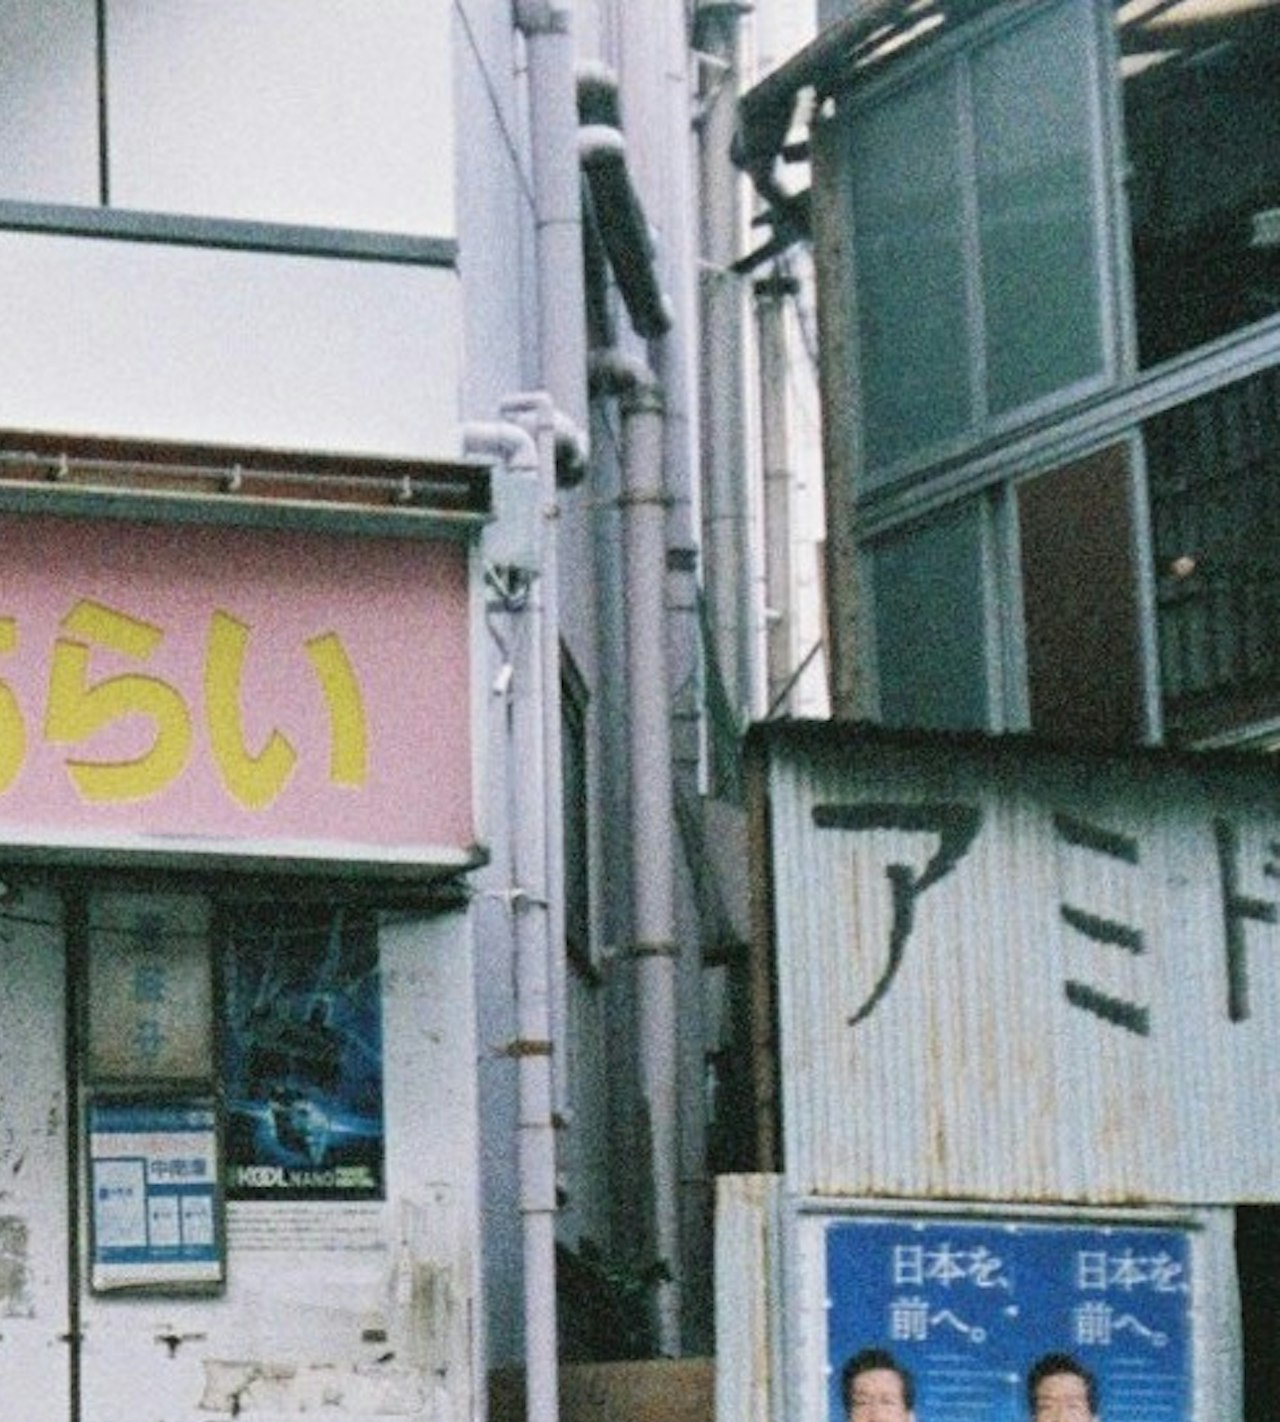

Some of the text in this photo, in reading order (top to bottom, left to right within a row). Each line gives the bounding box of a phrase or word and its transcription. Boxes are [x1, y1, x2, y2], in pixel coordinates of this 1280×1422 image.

[894, 1243, 1009, 1288] 日本を、
[892, 1297, 987, 1343] 前へ。
[1075, 1303, 1168, 1348] 前へ。
